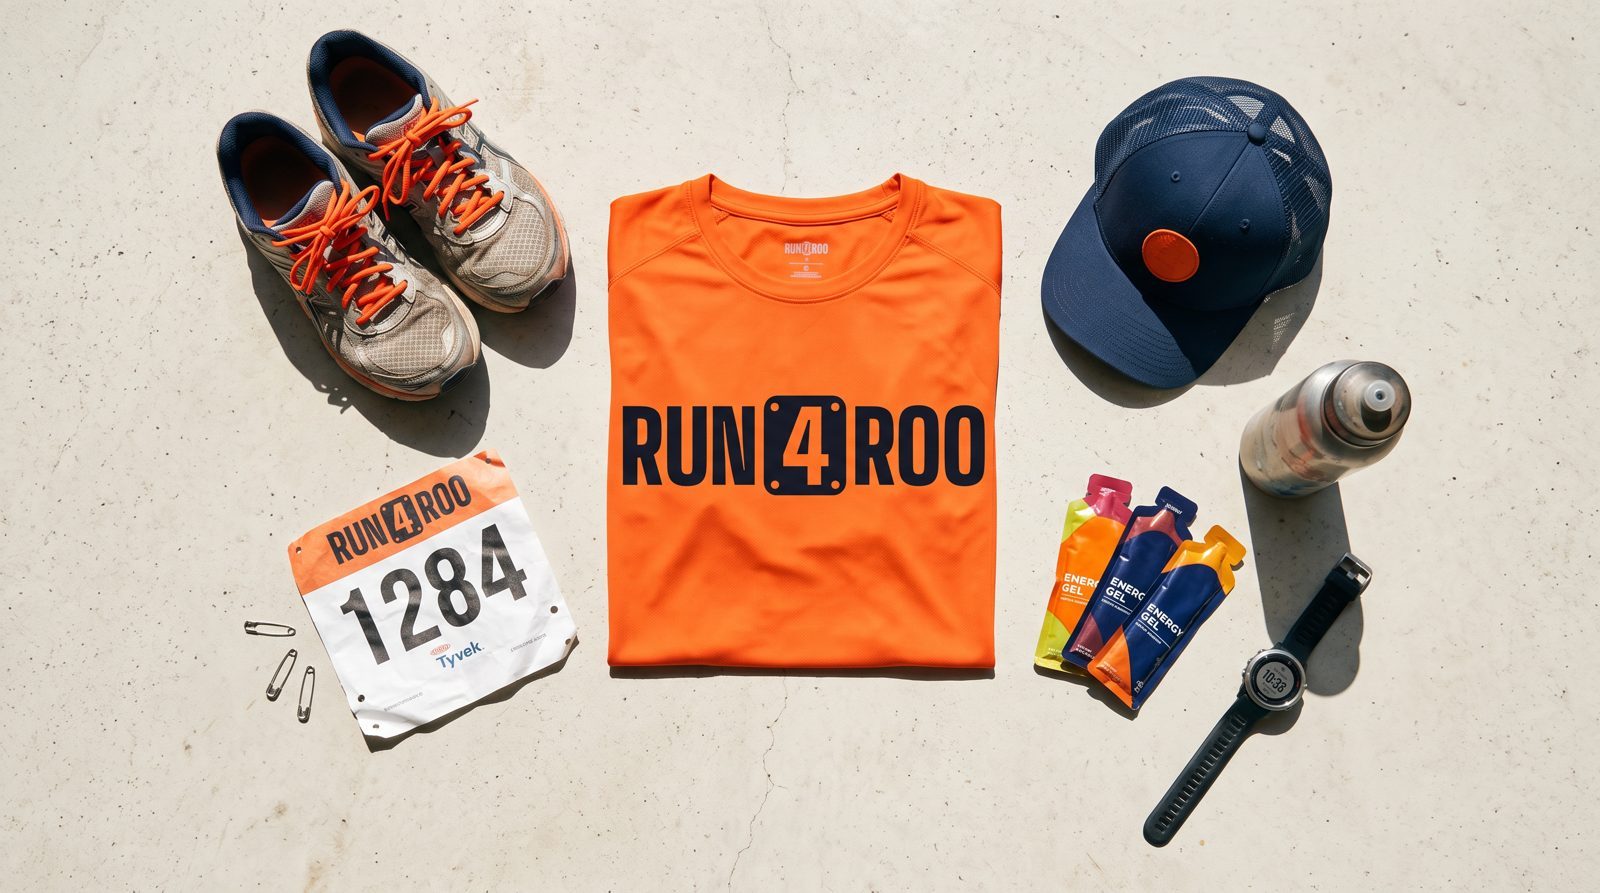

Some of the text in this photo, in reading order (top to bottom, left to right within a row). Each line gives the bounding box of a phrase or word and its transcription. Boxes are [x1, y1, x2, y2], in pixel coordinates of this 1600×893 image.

[622, 395, 986, 496] RUN4ROO
[325, 475, 472, 565] RUN4ROO
[1062, 584, 1083, 596] GEL
[1064, 573, 1100, 588] ENER
[1110, 576, 1146, 602] ENERG
[340, 523, 528, 665] 1284
[1105, 586, 1126, 604] GEL
[1140, 612, 1160, 632] GEL
[1146, 603, 1185, 637] ENERGY
